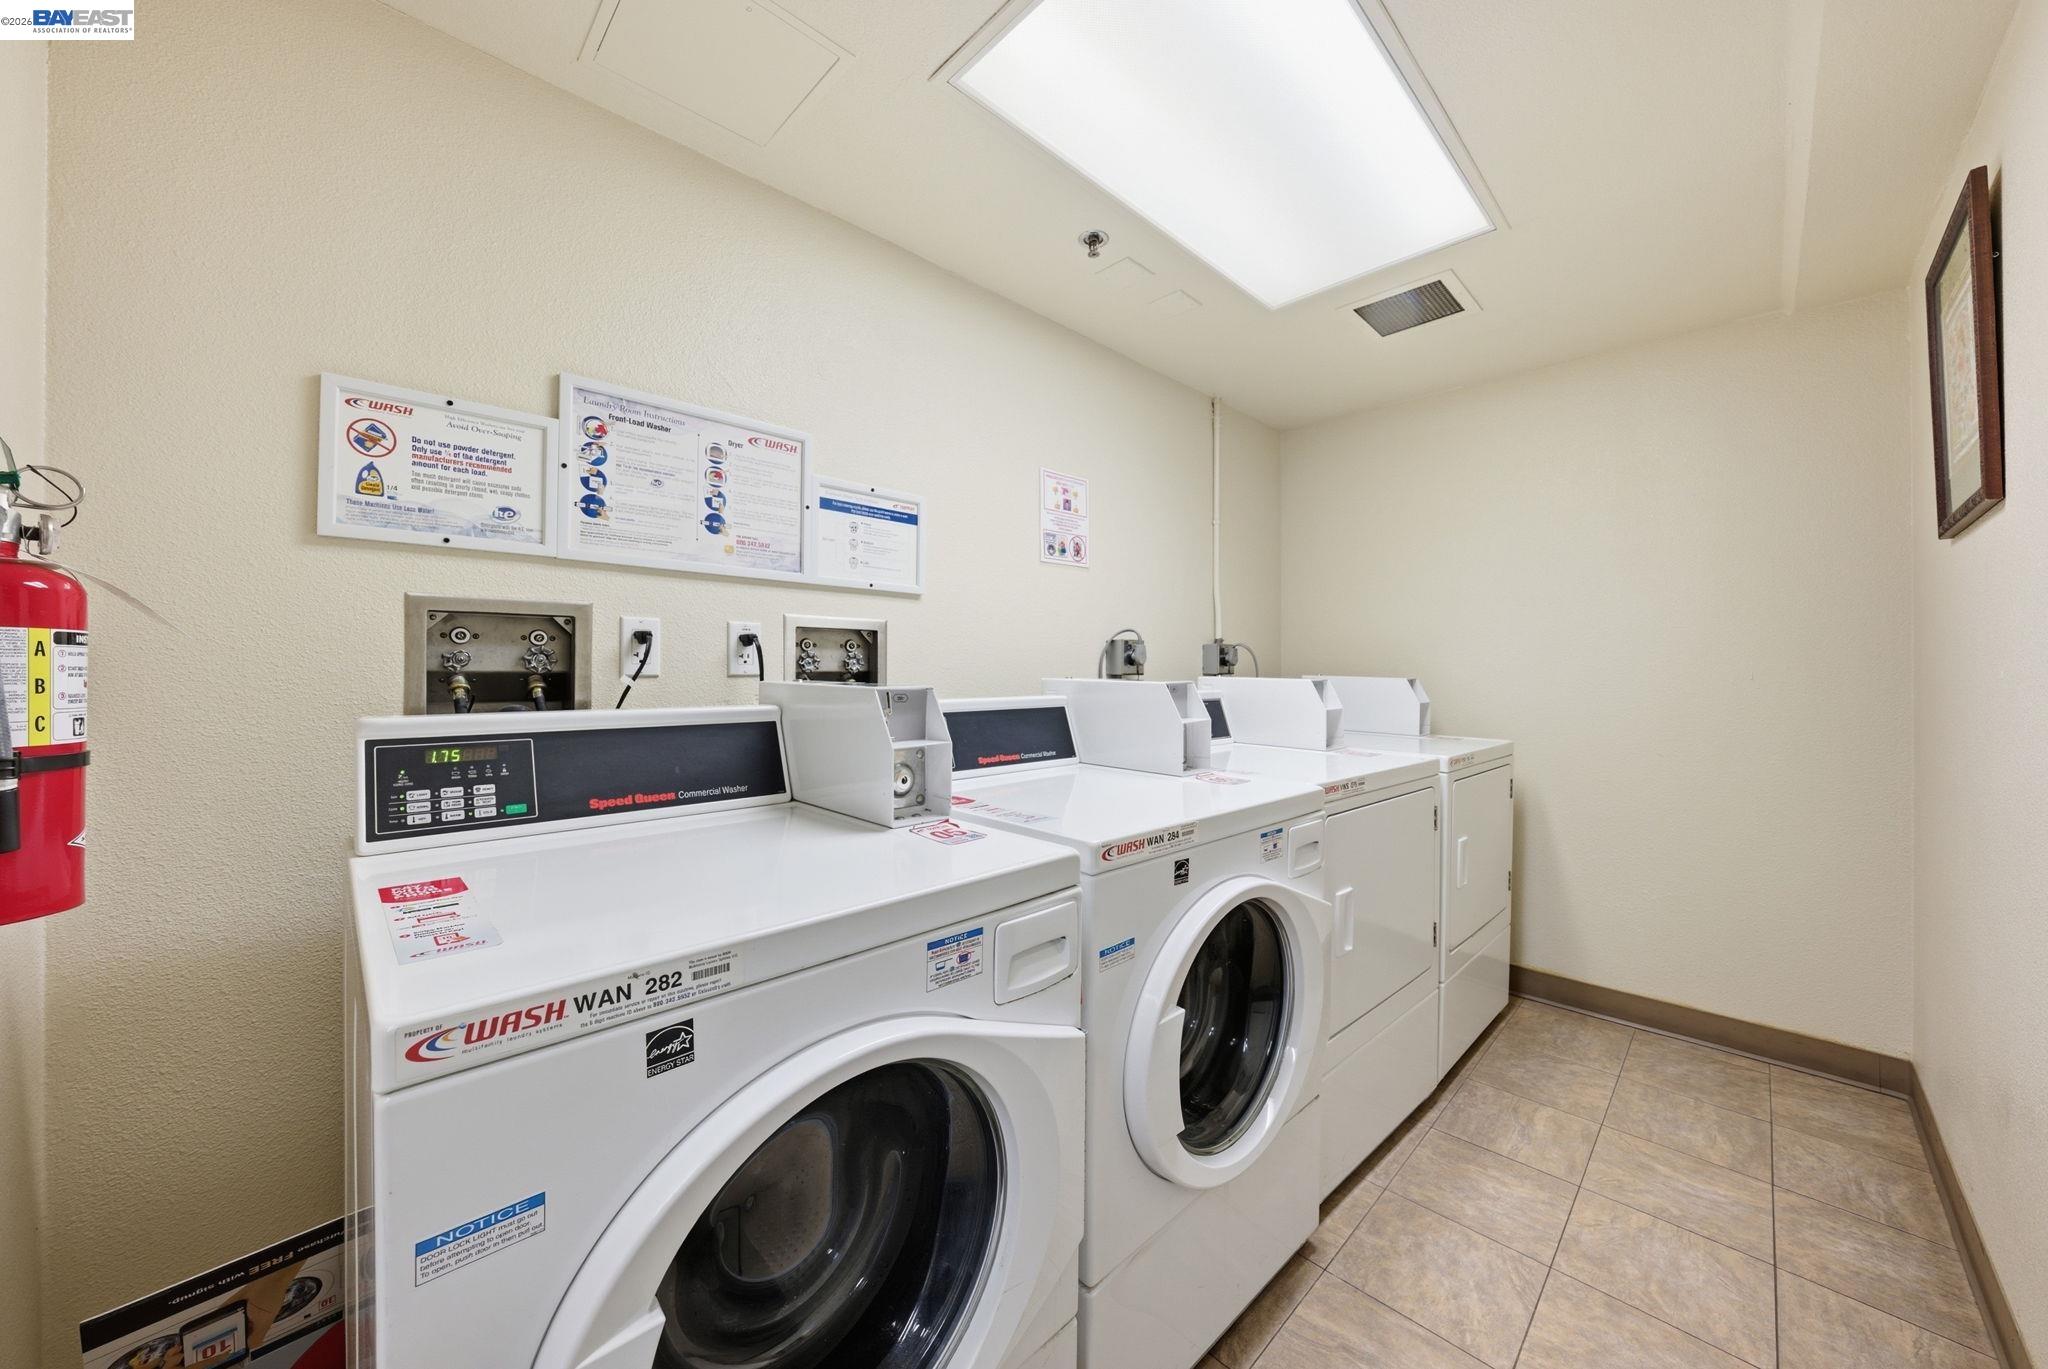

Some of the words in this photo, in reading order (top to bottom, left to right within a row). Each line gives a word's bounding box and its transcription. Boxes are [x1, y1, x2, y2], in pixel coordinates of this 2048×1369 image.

[368, 400, 413, 416] WASH
[583, 396, 617, 412] Laundry
[619, 404, 642, 417] Room
[643, 410, 686, 426] Instructions
[446, 421, 469, 431] Avoid
[608, 413, 645, 427] Front-Load
[646, 421, 672, 433] Washer
[411, 436, 421, 444] Do
[453, 443, 479, 454] powder
[481, 447, 516, 460] detergent.
[728, 439, 744, 449] Dryer
[765, 439, 798, 454] WASH
[411, 444, 427, 455] Only
[429, 448, 442, 456] use
[462, 452, 473, 461] the
[475, 455, 507, 466] detergent
[411, 453, 464, 466] manufacturers
[465, 462, 512, 474] recommended
[411, 461, 439, 470] amount
[440, 463, 451, 471] for
[453, 465, 469, 474] each
[471, 467, 488, 477] load.
[34, 641, 46, 657] A
[35, 678, 46, 694] B
[35, 715, 46, 732] C
[431, 749, 460, 764] 1.75
[589, 794, 633, 810] Speed
[634, 791, 676, 804] Queen
[678, 786, 721, 799] Commercial
[722, 784, 748, 794] Washer
[1116, 838, 1146, 856] WASH
[1146, 834, 1165, 847] WAN
[944, 933, 969, 945] NOTICE
[574, 983, 632, 1014] WAN
[645, 971, 683, 995] 282
[404, 1026, 434, 1038] PROPERTY
[464, 999, 567, 1045] WASH
[506, 1031, 532, 1042] laundry
[535, 1023, 563, 1034] systems
[647, 1060, 676, 1077] ENERGY
[676, 1054, 694, 1066] STAR
[436, 1200, 530, 1247] NOTICE
[420, 1249, 447, 1264] DOOR
[448, 1238, 471, 1253] LOCK
[472, 1226, 497, 1243] LIGHT
[498, 1219, 516, 1231] must
[516, 1216, 526, 1224] go
[527, 1210, 538, 1219] out
[420, 1258, 445, 1272] before
[446, 1240, 486, 1261] attempting
[495, 1228, 514, 1240] open
[420, 1270, 430, 1279] To
[454, 1253, 473, 1265] push
[475, 1245, 492, 1256] door
[493, 1240, 500, 1248] in
[501, 1234, 517, 1244] then
[517, 1227, 531, 1240] pull
[249, 1251, 294, 1275] FREE
[218, 1271, 246, 1286] with
[168, 1283, 215, 1305] signup.
